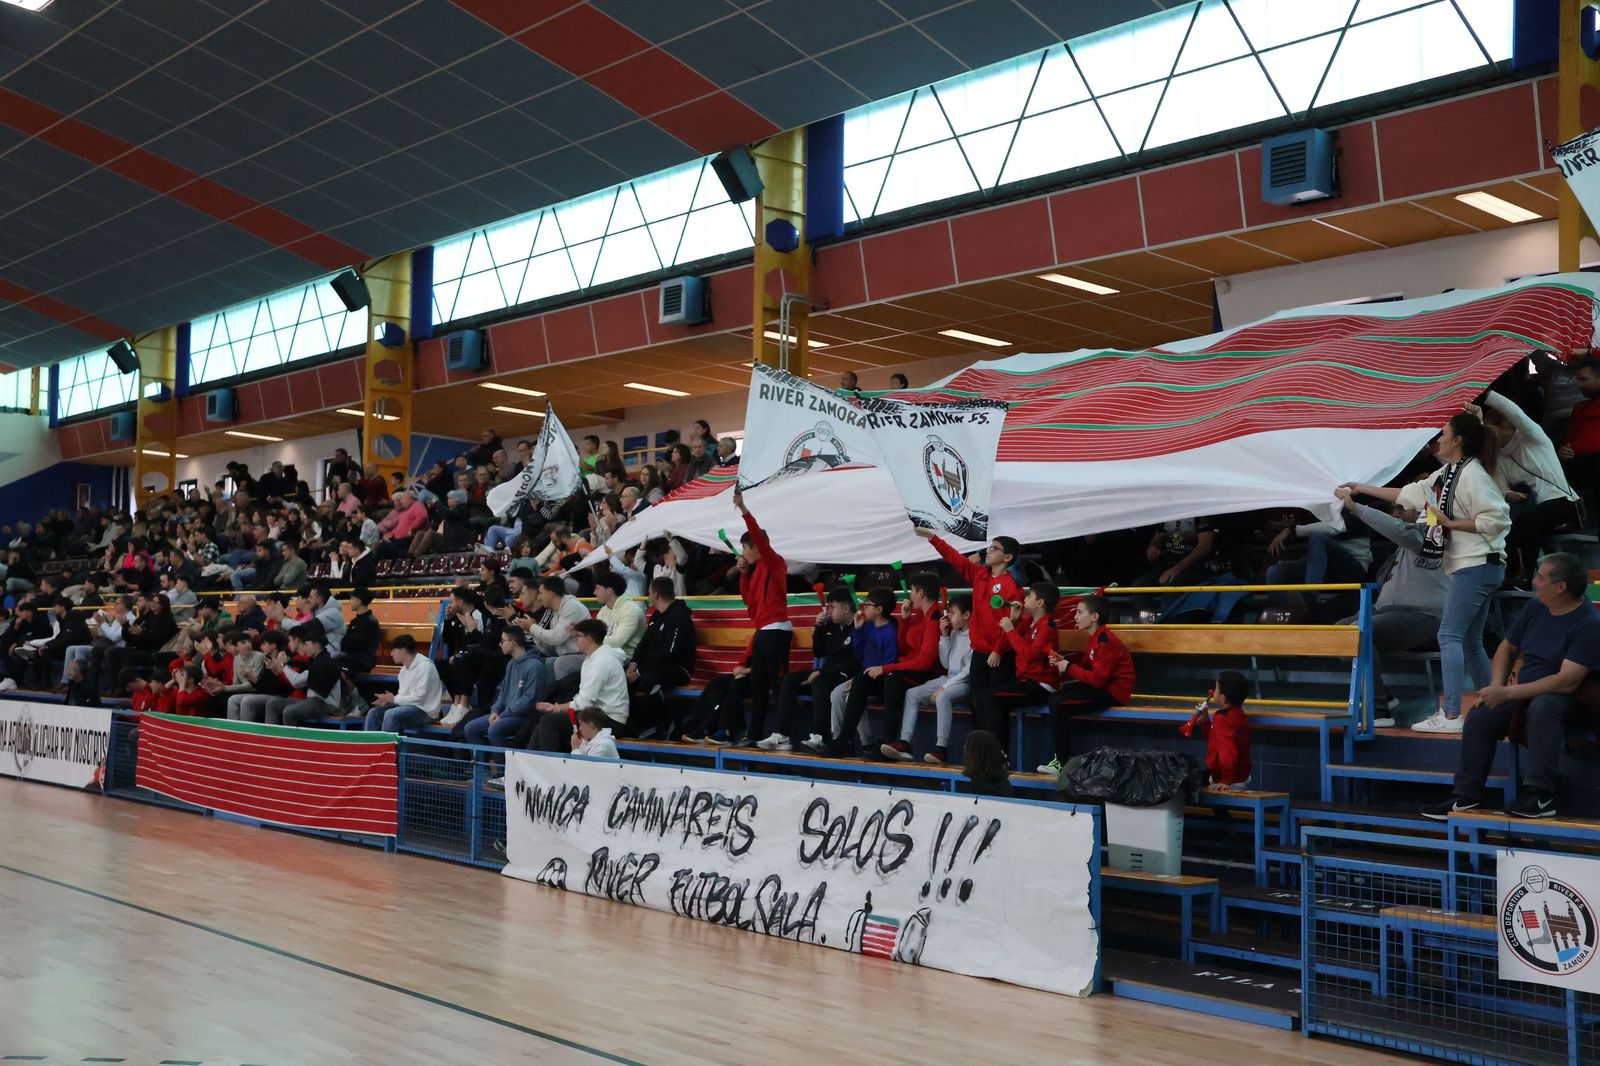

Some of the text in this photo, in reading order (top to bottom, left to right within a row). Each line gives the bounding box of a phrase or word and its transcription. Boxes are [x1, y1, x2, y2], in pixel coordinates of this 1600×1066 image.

[759, 383, 867, 429] RIVER ZAMORA
[605, 785, 759, 857] CAMINAREIS
[799, 797, 915, 875] SOLOS
[585, 846, 661, 905] RIVER
[1553, 883, 1575, 899] RIVER
[1504, 889, 1524, 926] DEPORTIVO
[1506, 928, 1519, 947] CLUB
[1562, 949, 1590, 971] ZAMORA
